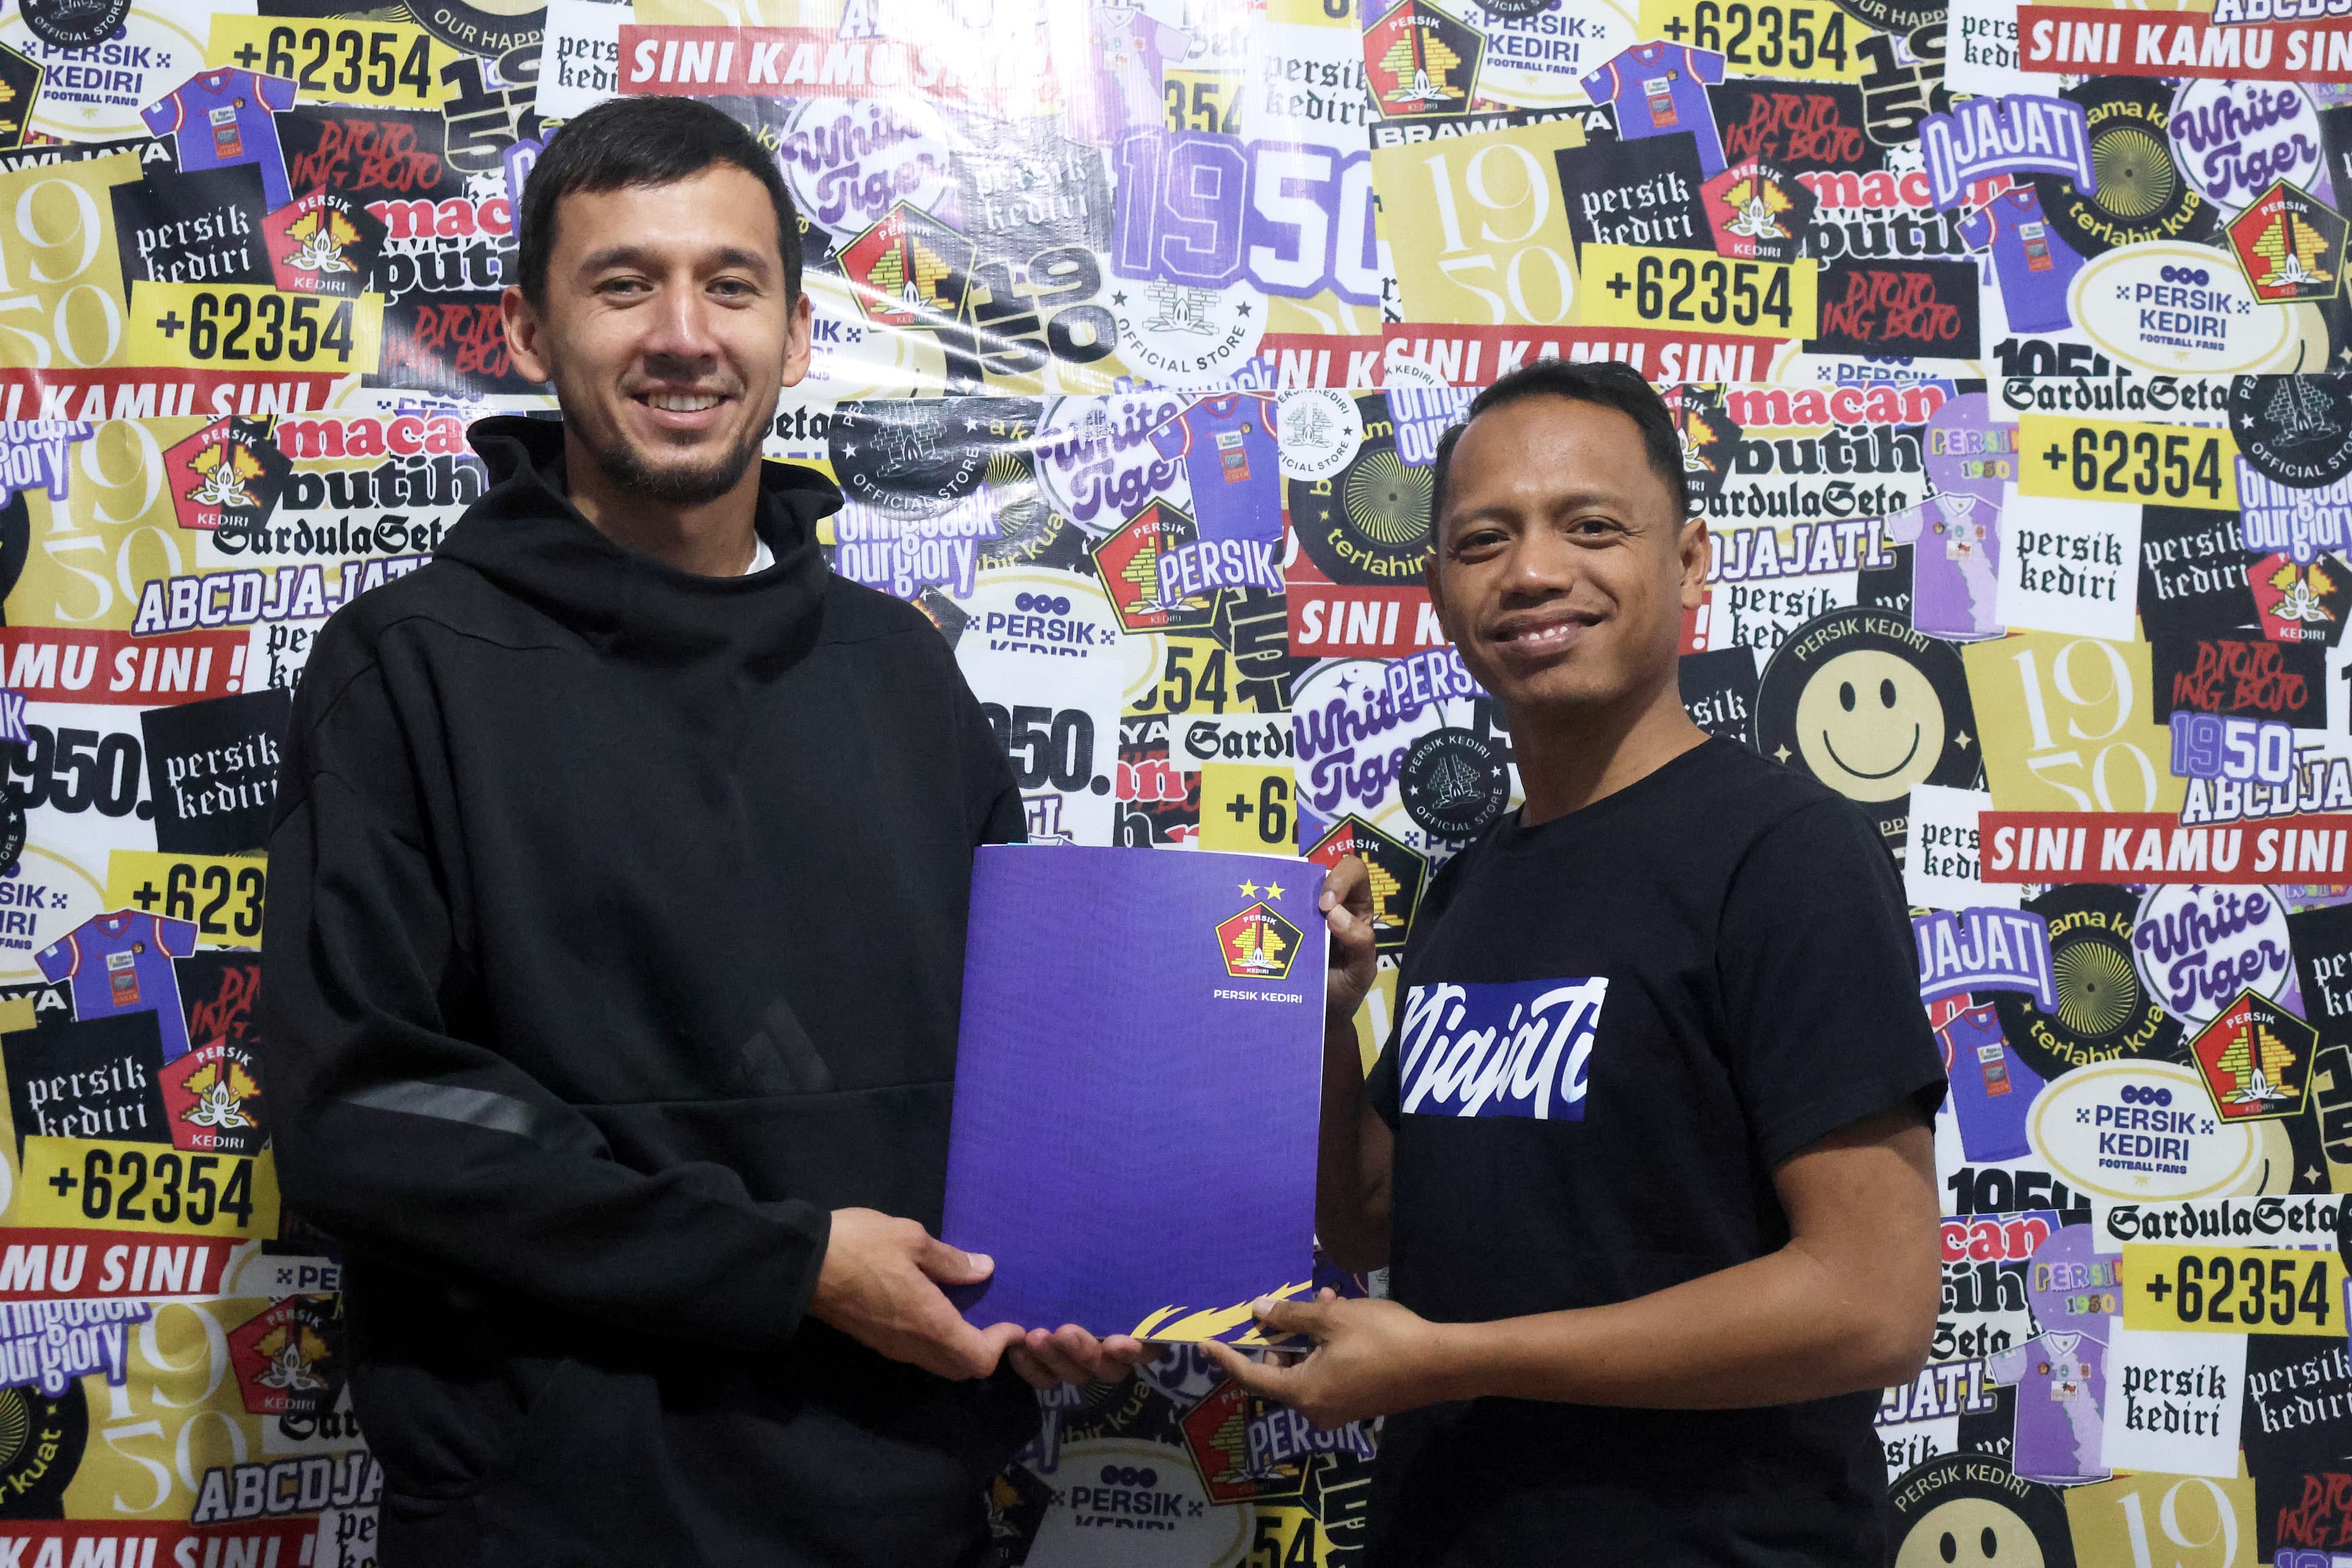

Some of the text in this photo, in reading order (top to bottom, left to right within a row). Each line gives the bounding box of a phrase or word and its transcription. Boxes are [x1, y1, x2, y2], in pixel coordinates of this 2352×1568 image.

[34, 16, 91, 42] OFFICIAL
[435, 9, 476, 43] OUR
[1389, 16, 1440, 32] PERSIK
[1483, 12, 1586, 38] PERSIK
[1663, 1, 1847, 71] +62354
[2030, 20, 2122, 64] SINI
[2135, 26, 2274, 69] KAMU
[42, 42, 151, 68] PERSIK
[233, 27, 432, 99] +62354
[631, 39, 734, 84] SINI
[748, 42, 913, 86] KAMU
[1487, 34, 1579, 62] KEDIRI
[1488, 58, 1577, 75] FOOTBALL FANS
[43, 90, 139, 106] FOOTBALL FANS
[45, 64, 143, 93] KEDIRI
[1264, 88, 1367, 127] kediri
[2170, 82, 2301, 153] White
[782, 101, 929, 169] White
[1926, 100, 2090, 205] DJAJATI
[1732, 165, 1785, 184] PERSIK
[2203, 133, 2317, 199] Tiger
[298, 195, 351, 214] PERSIK
[816, 153, 948, 224] Tiger
[1423, 143, 1550, 254] 19
[1582, 172, 1690, 223] persik
[2261, 201, 2309, 216] PERSIK
[137, 205, 251, 258] persik
[1122, 134, 1379, 295] 1950
[1592, 205, 1694, 245] kediri
[146, 242, 251, 283] kediri
[1734, 243, 1781, 258] KEDIRI
[295, 276, 346, 293] KEDIRI
[1605, 256, 1793, 328] +62354
[2136, 284, 2232, 314] PERSIK
[156, 293, 354, 363] +62354
[1119, 318, 1246, 372] OFFICIAL STORE
[2140, 310, 2226, 338] KEDIRI
[2140, 334, 2224, 351] FOOTBALL FANS
[1395, 364, 1435, 385] KEDIRI
[1658, 343, 1755, 383] SINI
[2003, 376, 2229, 412] SardulaSeta
[201, 428, 257, 448] PERSIK
[1036, 403, 1177, 471] White
[1318, 440, 1351, 470] STORE
[1732, 426, 1921, 474] putih
[938, 447, 979, 501] STORE
[2043, 427, 2222, 499] +62354
[2251, 443, 2324, 479] OFFICIAL
[197, 513, 249, 527] KEDIRI
[1133, 521, 1186, 539] PERSIK
[2017, 529, 2122, 566] persik
[2143, 520, 2245, 568] persik
[1158, 539, 1278, 606] PERSIK
[2021, 557, 2116, 602] kediri
[2155, 556, 2249, 599] kediri
[985, 612, 1096, 645] PERSIK
[1298, 599, 1400, 645] SINI
[1794, 618, 1930, 661] PERSIK KEDIRI
[2280, 627, 2325, 641] KEDIRI
[109, 647, 223, 691] SINI
[2011, 639, 2134, 750] 19
[166, 732, 281, 789] persik
[1409, 735, 1491, 774] PERSIK KEDIRI
[2172, 713, 2291, 779] 1950
[176, 769, 278, 819] kediri
[1417, 787, 1503, 831] OFFICIAL STORE
[1327, 839, 1380, 856] PERSIK
[1991, 827, 2347, 873] SINI KAMU SINI
[1243, 914, 1277, 925] PERSIK
[2134, 893, 2270, 963] White
[1214, 989, 1302, 1004] PERSIK KEDIRI
[2168, 939, 2286, 1012] Tiger
[2226, 1012, 2275, 1028] PERSIK
[196, 1047, 253, 1066] PERSIK
[28, 1056, 147, 1112] persik
[39, 1094, 148, 1138] kediri
[2095, 1106, 2197, 1135] PERSIK
[192, 1135, 245, 1148] KEDIRI
[2099, 1133, 2188, 1161] KEDIRI
[2099, 1158, 2186, 1174] FOOTBALL FANS
[49, 1149, 253, 1227] +62354
[2107, 1197, 2337, 1241] SardulaSeta
[99, 1246, 210, 1292] SINI
[2147, 1255, 2329, 1327] +62354
[266, 1307, 322, 1328] PERSIK
[2122, 1364, 2226, 1400] persik
[2249, 1347, 2350, 1403] persik
[264, 1396, 316, 1411] KEDIRI
[2126, 1392, 2220, 1438] kediri
[8, 1428, 62, 1496] kuat
[1071, 1487, 1182, 1517] PERSIK
[1895, 1463, 2031, 1512] PERSIK KEDIRI
